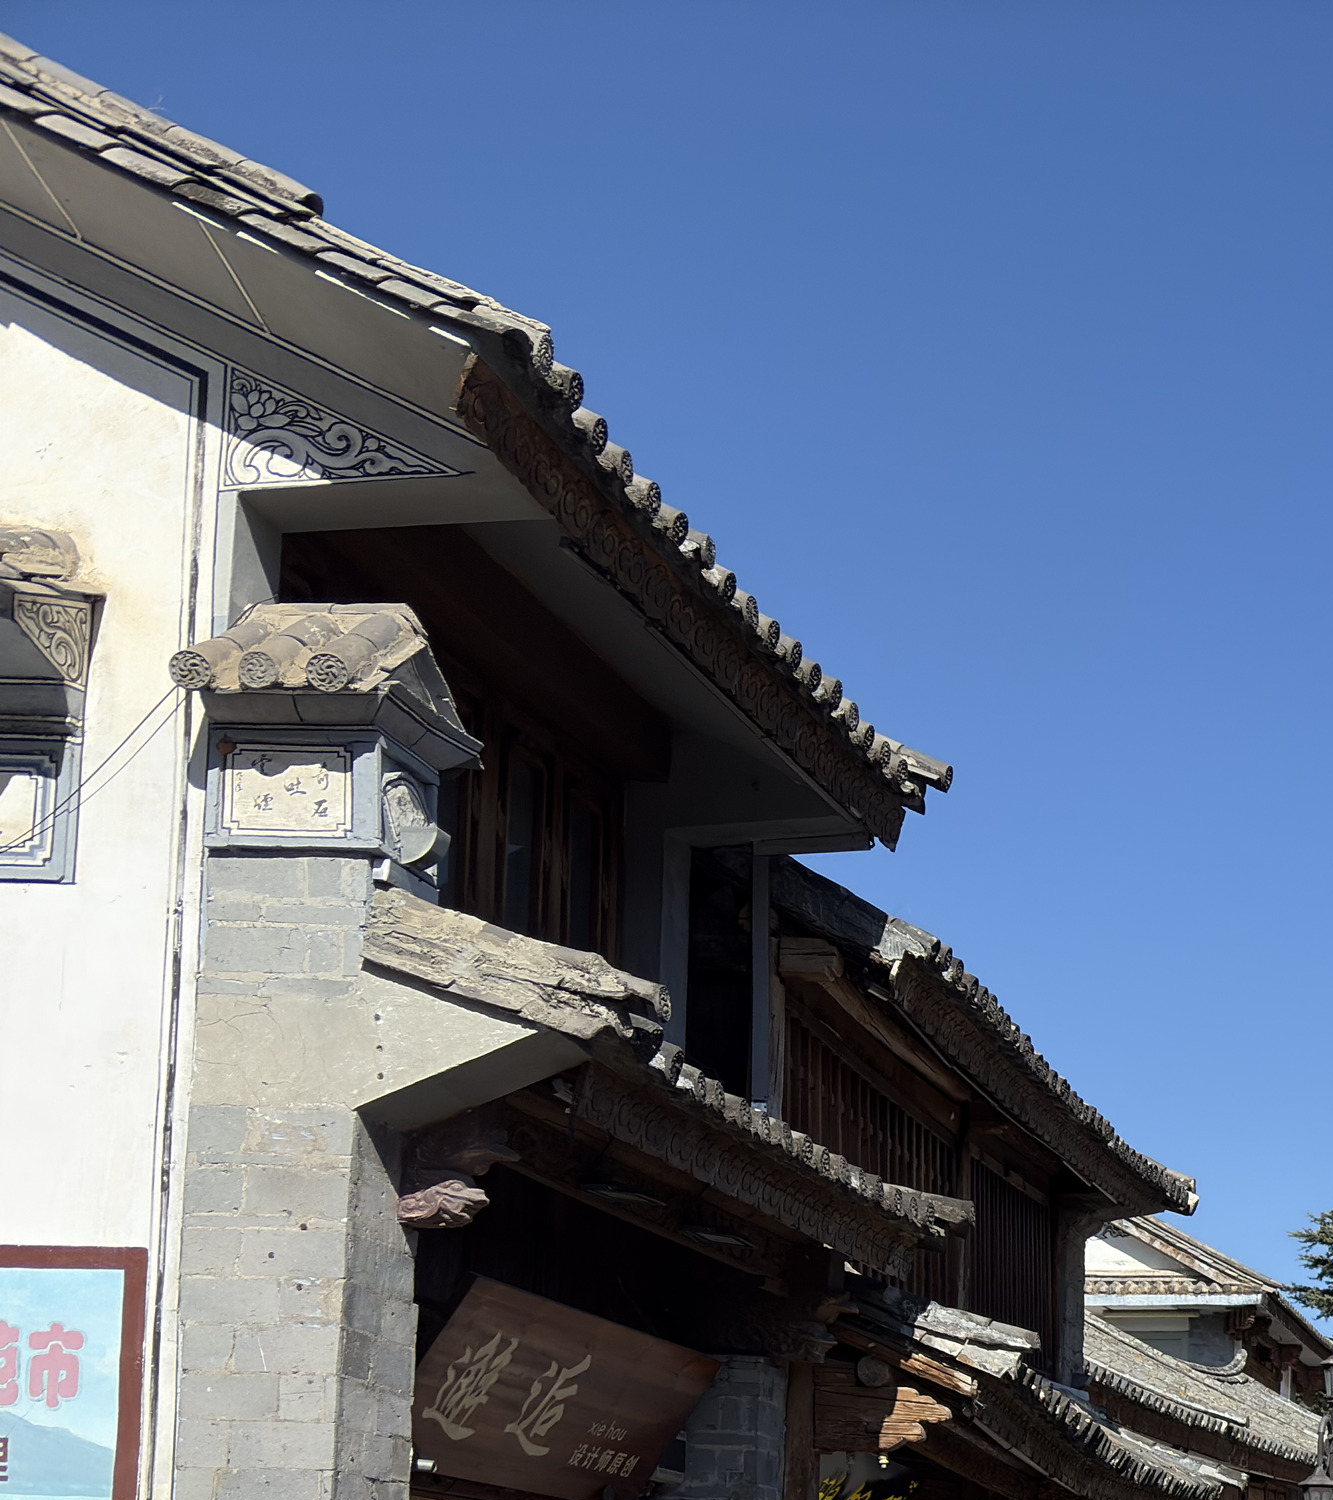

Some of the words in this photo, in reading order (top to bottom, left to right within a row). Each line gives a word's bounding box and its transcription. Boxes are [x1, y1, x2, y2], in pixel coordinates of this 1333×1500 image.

[422, 1330, 592, 1456] 邂逅
[588, 1421, 605, 1438] xie
[606, 1422, 627, 1440] hou
[568, 1444, 640, 1478] 设计师原创
